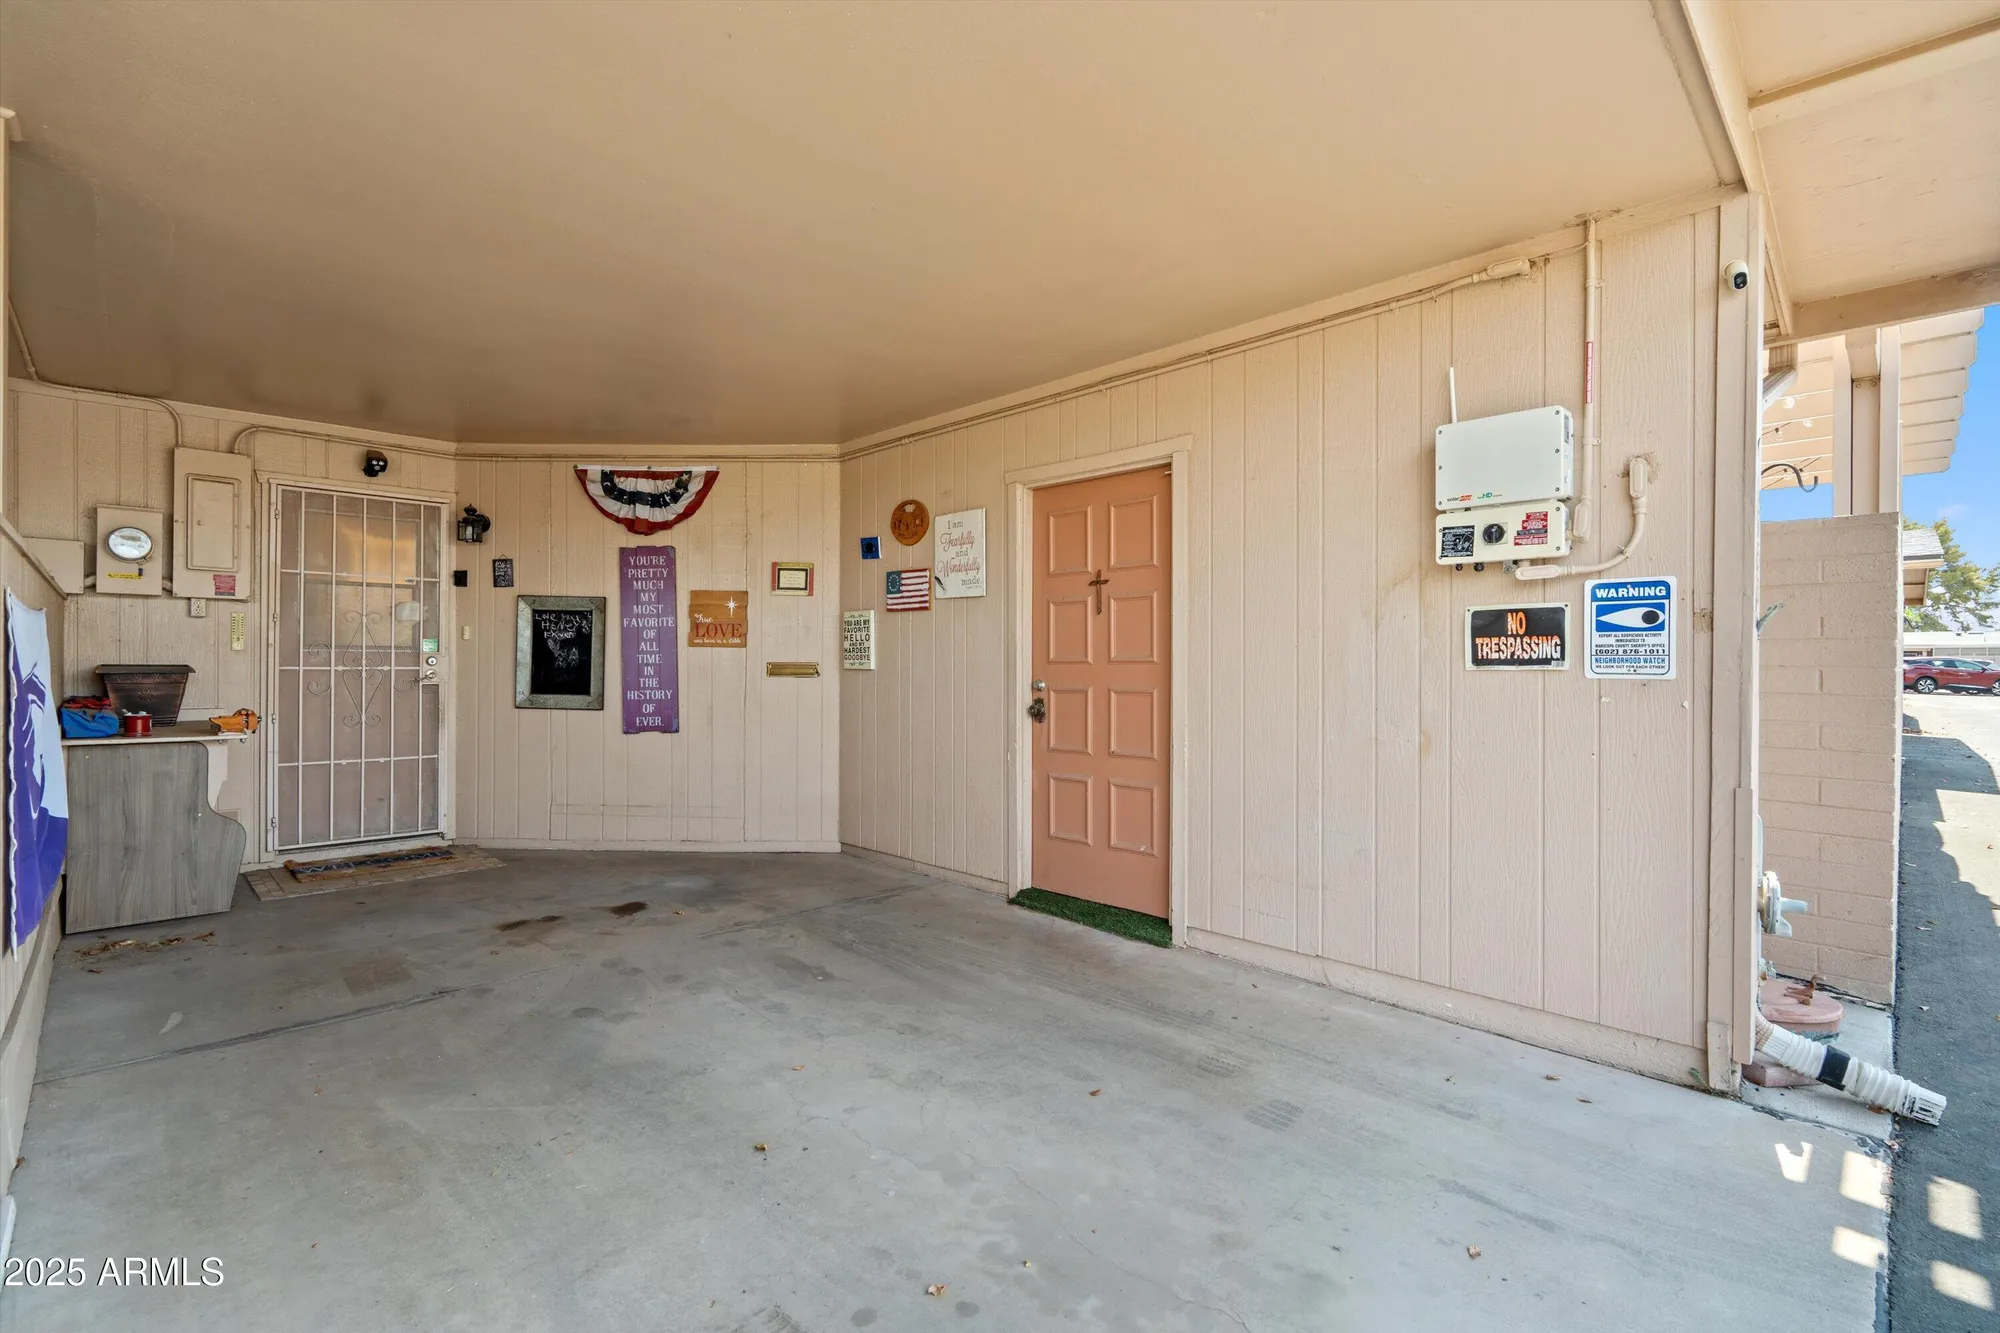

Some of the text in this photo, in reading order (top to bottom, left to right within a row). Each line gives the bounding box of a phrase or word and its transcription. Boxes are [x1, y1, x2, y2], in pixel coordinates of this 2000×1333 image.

[948, 520, 964, 529] I am
[940, 530, 975, 552] Fearfully
[955, 547, 968, 557] and
[629, 556, 666, 565] YOU'RE
[936, 557, 980, 577] Wonderfully
[628, 568, 669, 578] PRETTY
[633, 580, 664, 590] MUCH
[961, 575, 982, 586] made.
[640, 592, 657, 601] MY
[1595, 586, 1667, 598] WARNING
[633, 604, 664, 614] MOST
[623, 617, 675, 627] FAVORITE
[1507, 611, 1526, 635] NO
[643, 629, 657, 639] OF
[695, 623, 742, 638] LOVE
[843, 633, 870, 642] HELLO
[639, 641, 659, 651] ALL
[1475, 635, 1561, 660] TRESPASSING
[636, 654, 662, 663] TIME
[644, 666, 654, 675] IN
[639, 677, 659, 687] THE
[627, 690, 673, 700] HISTORY
[642, 703, 656, 713] OF
[636, 716, 664, 726] EVER.
